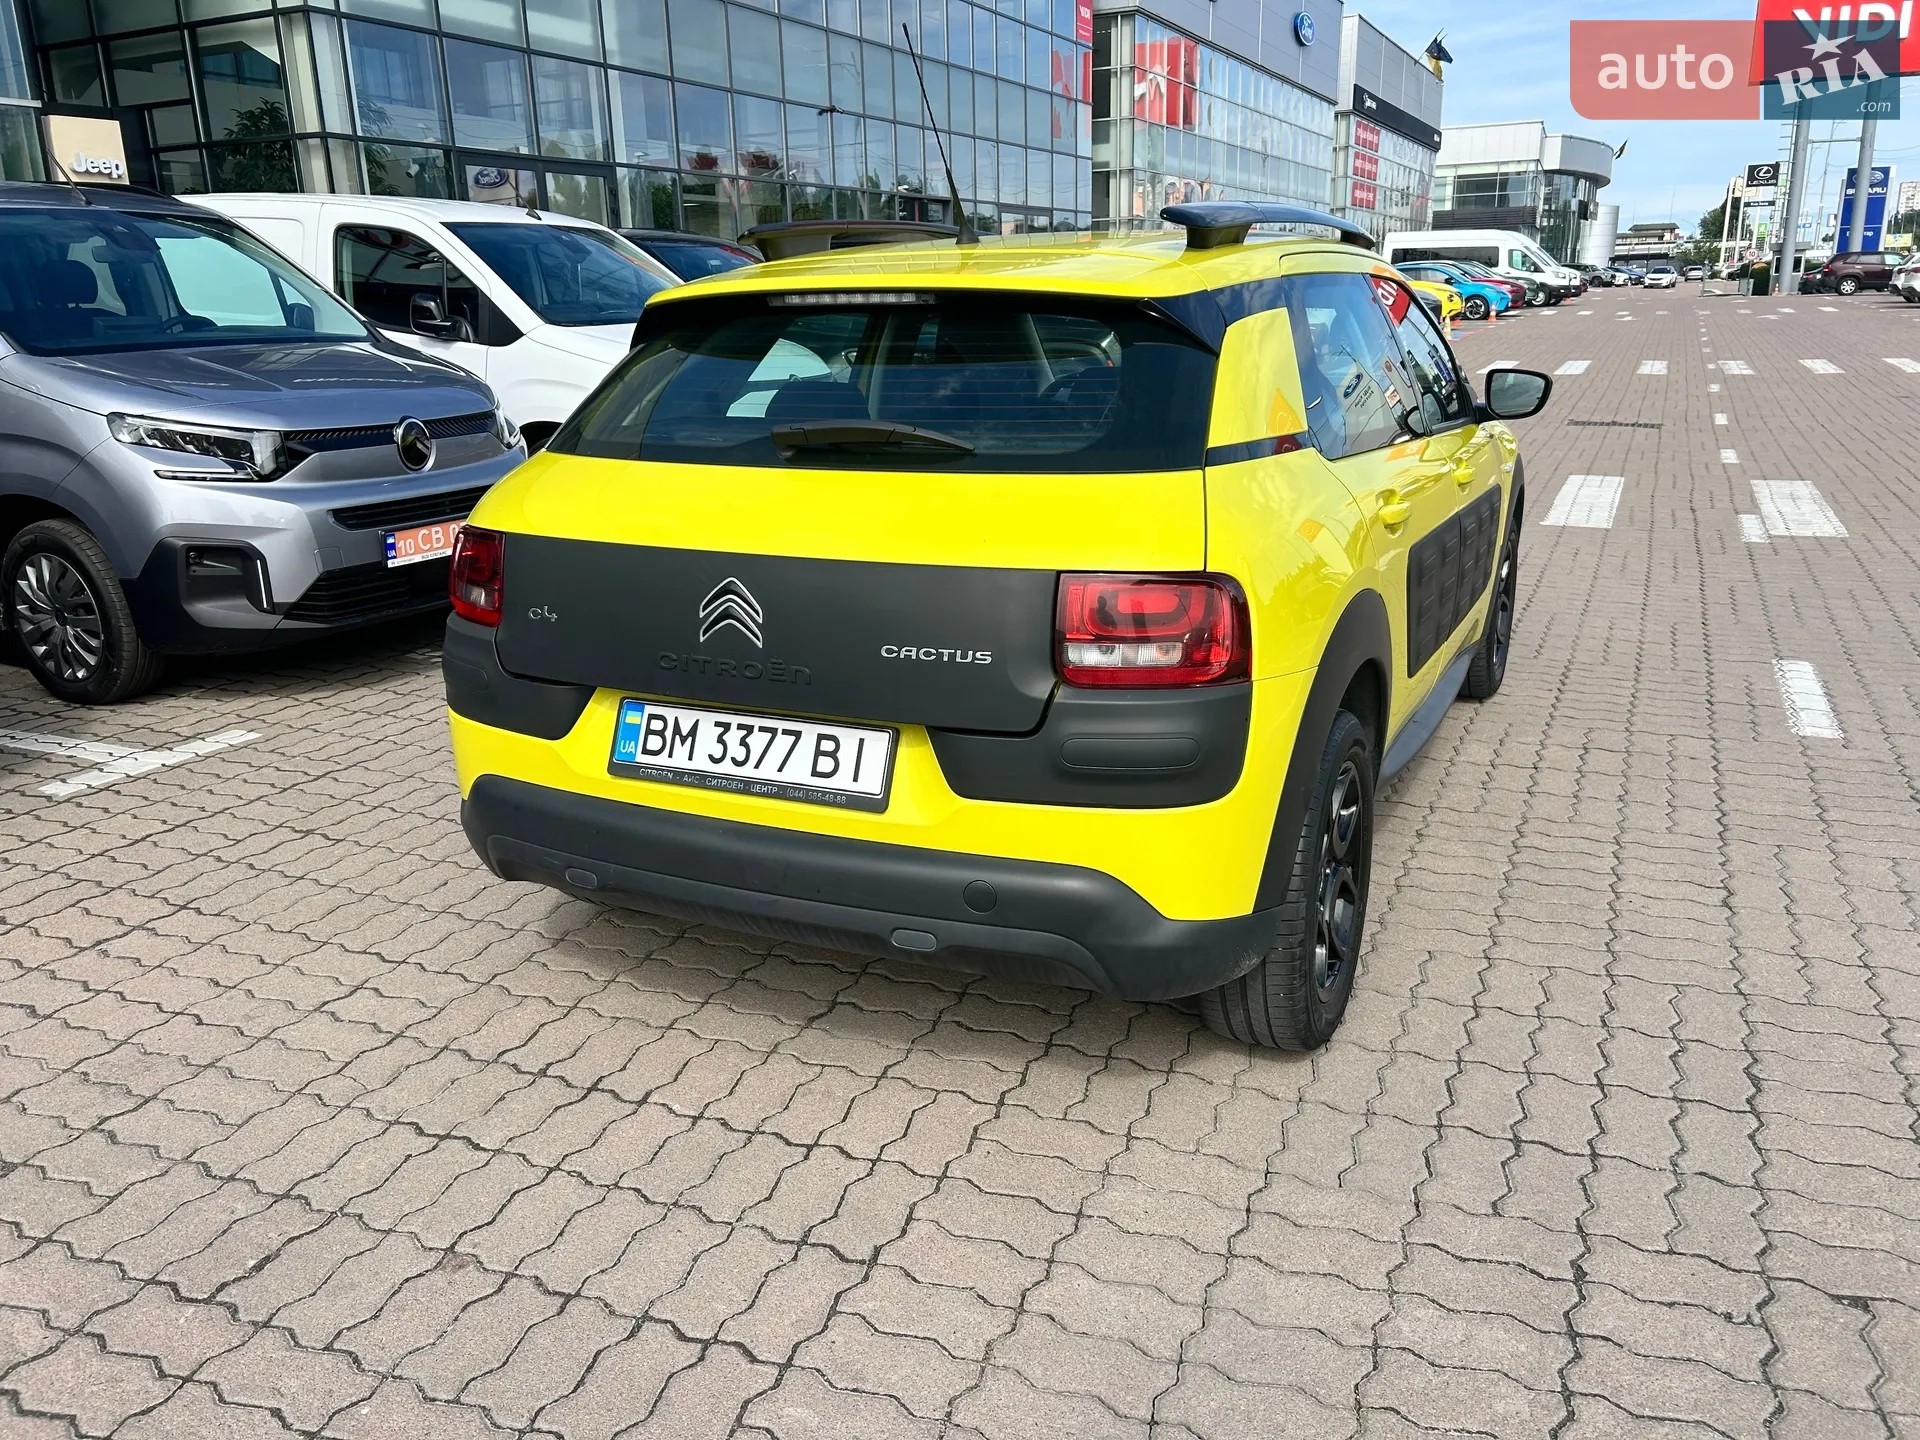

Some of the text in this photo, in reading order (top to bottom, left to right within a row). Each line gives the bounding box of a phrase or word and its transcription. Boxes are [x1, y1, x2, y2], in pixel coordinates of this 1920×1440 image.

[1792, 0, 1914, 44] VIDI
[70, 151, 125, 179] Jeep
[1748, 250, 1756, 258] 10
[387, 549, 397, 558] UA
[397, 538, 415, 557] 10
[418, 526, 445, 551] CB
[880, 645, 993, 664] CACTUS
[620, 739, 636, 755] UA
[640, 713, 866, 783] BM 3377 BI
[705, 777, 744, 790] СИТРОЕН
[750, 783, 778, 794] ЦЕНТР
[786, 788, 806, 799] (044)
[808, 791, 847, 804] 585-48-88
